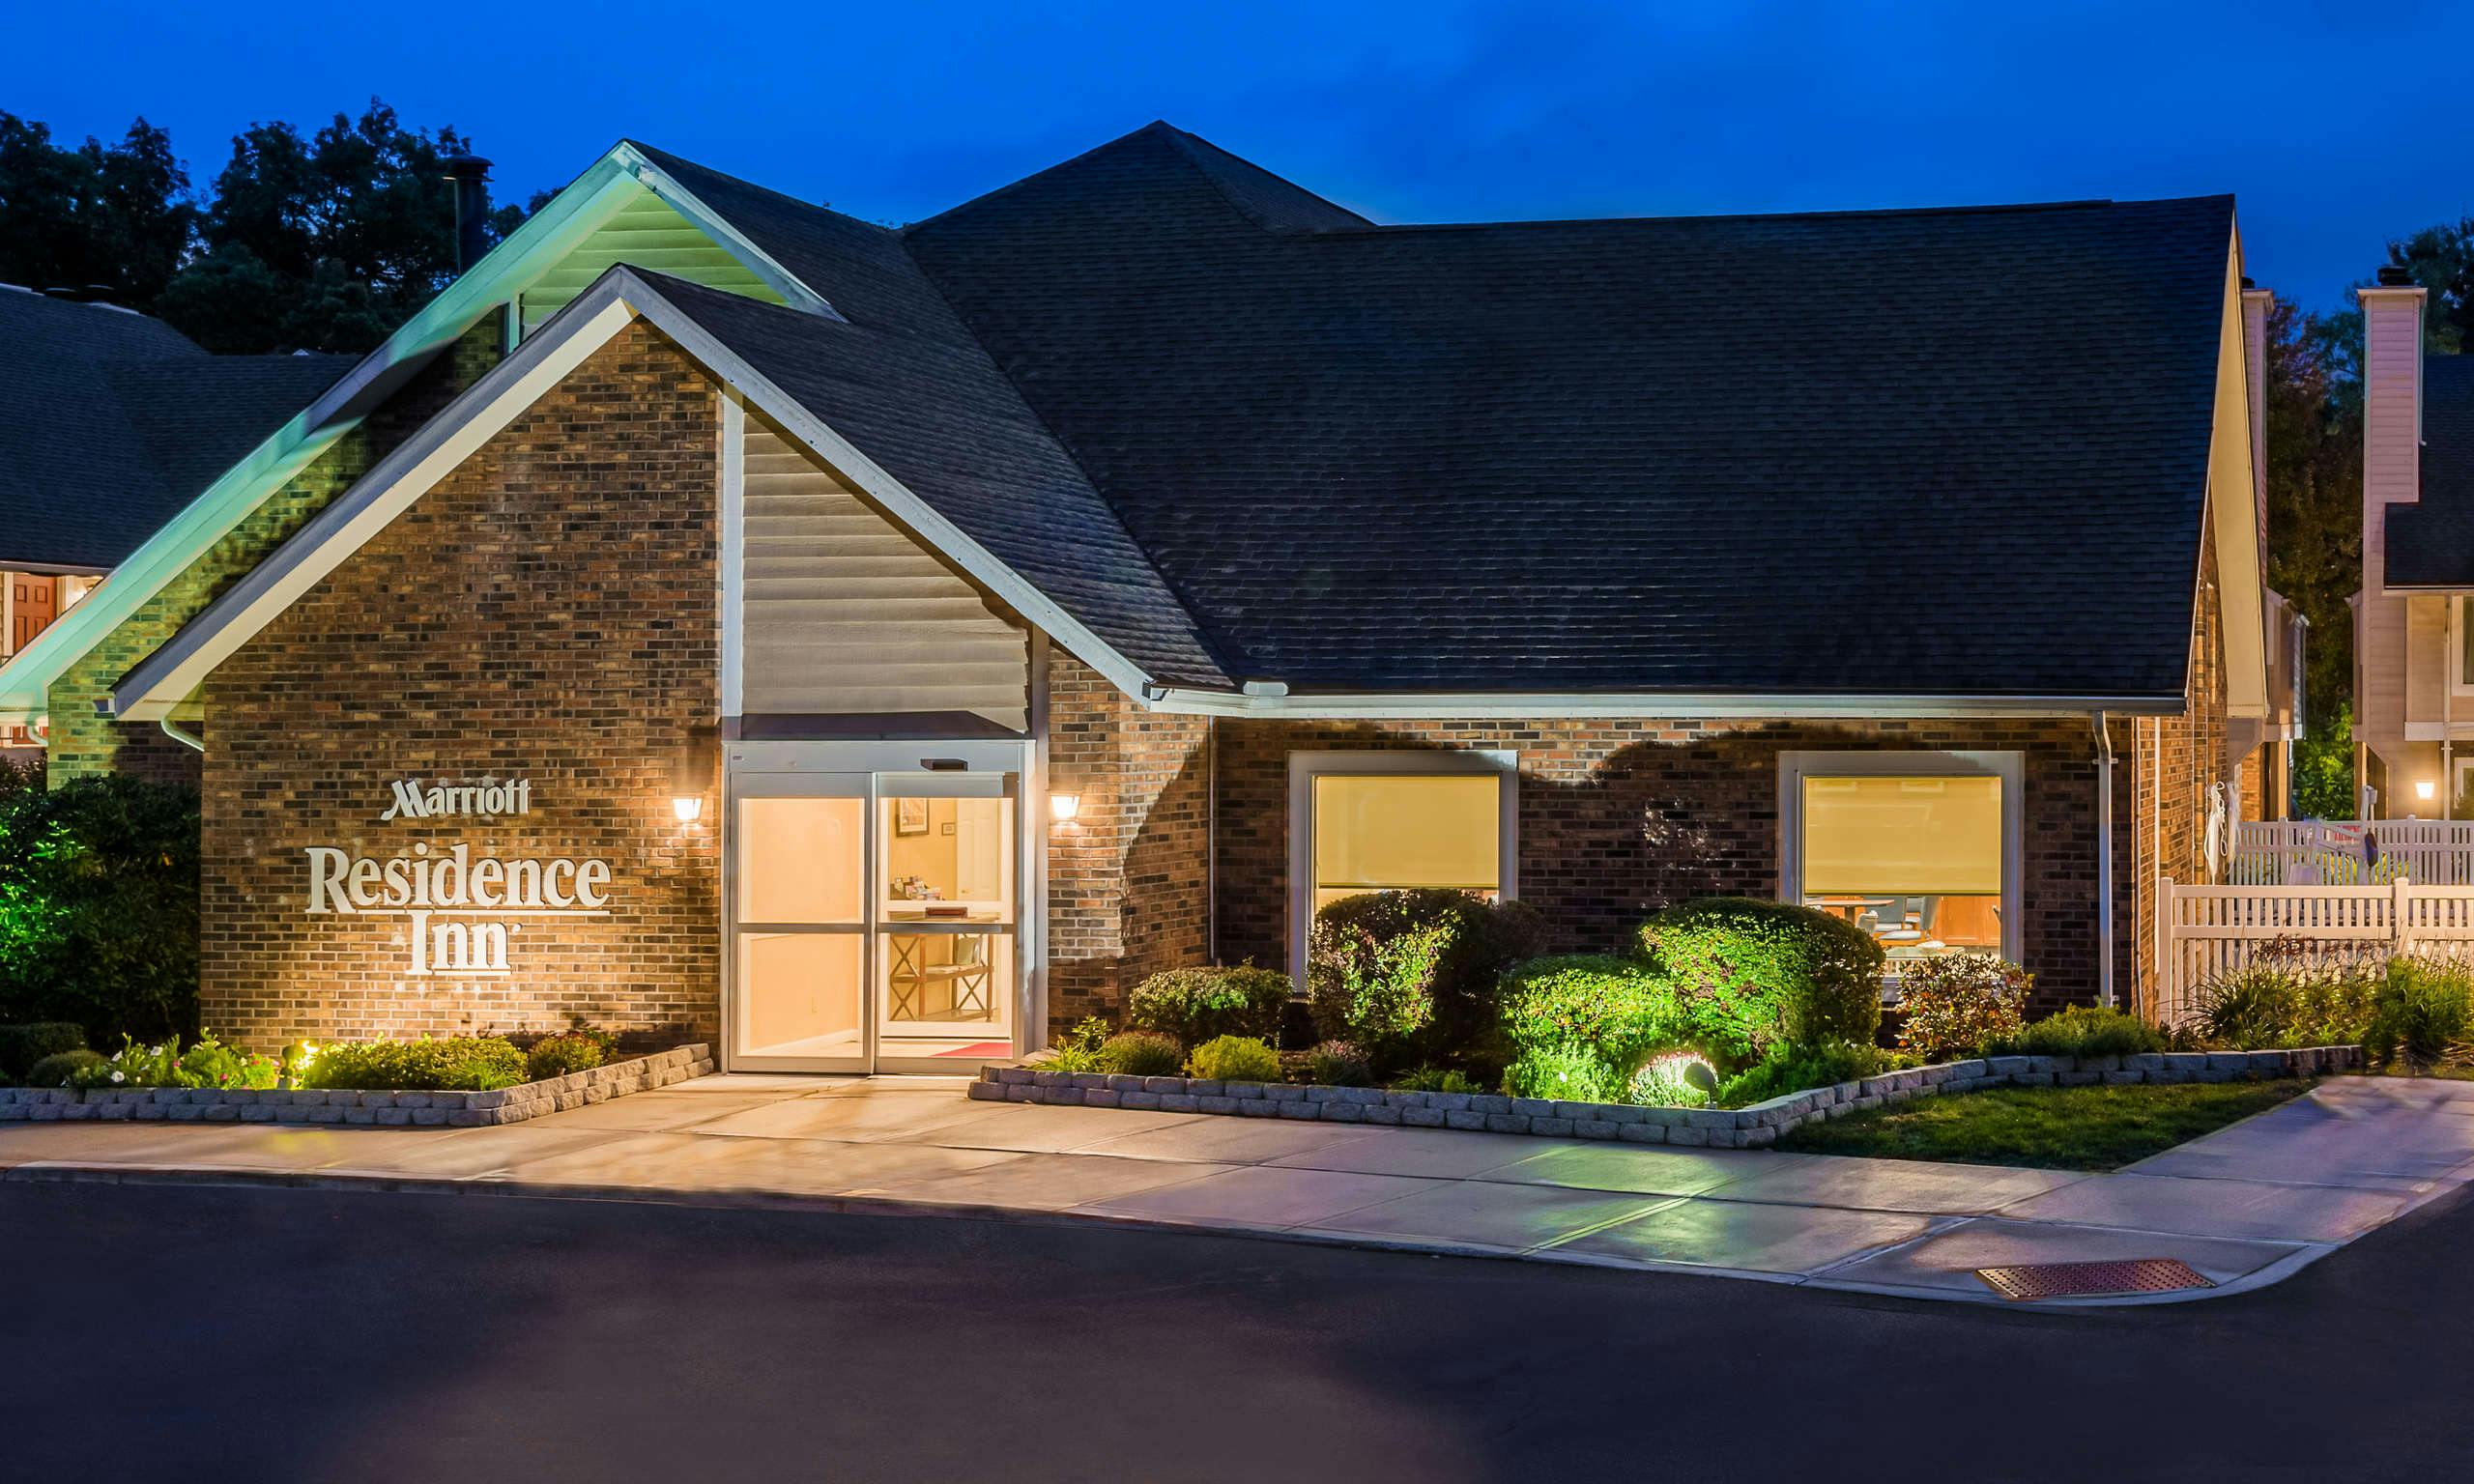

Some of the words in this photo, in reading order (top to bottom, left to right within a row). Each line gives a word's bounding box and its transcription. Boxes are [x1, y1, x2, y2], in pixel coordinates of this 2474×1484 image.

[380, 778, 531, 821] Marriott
[304, 842, 612, 914] Residence
[405, 910, 512, 976] Inn
